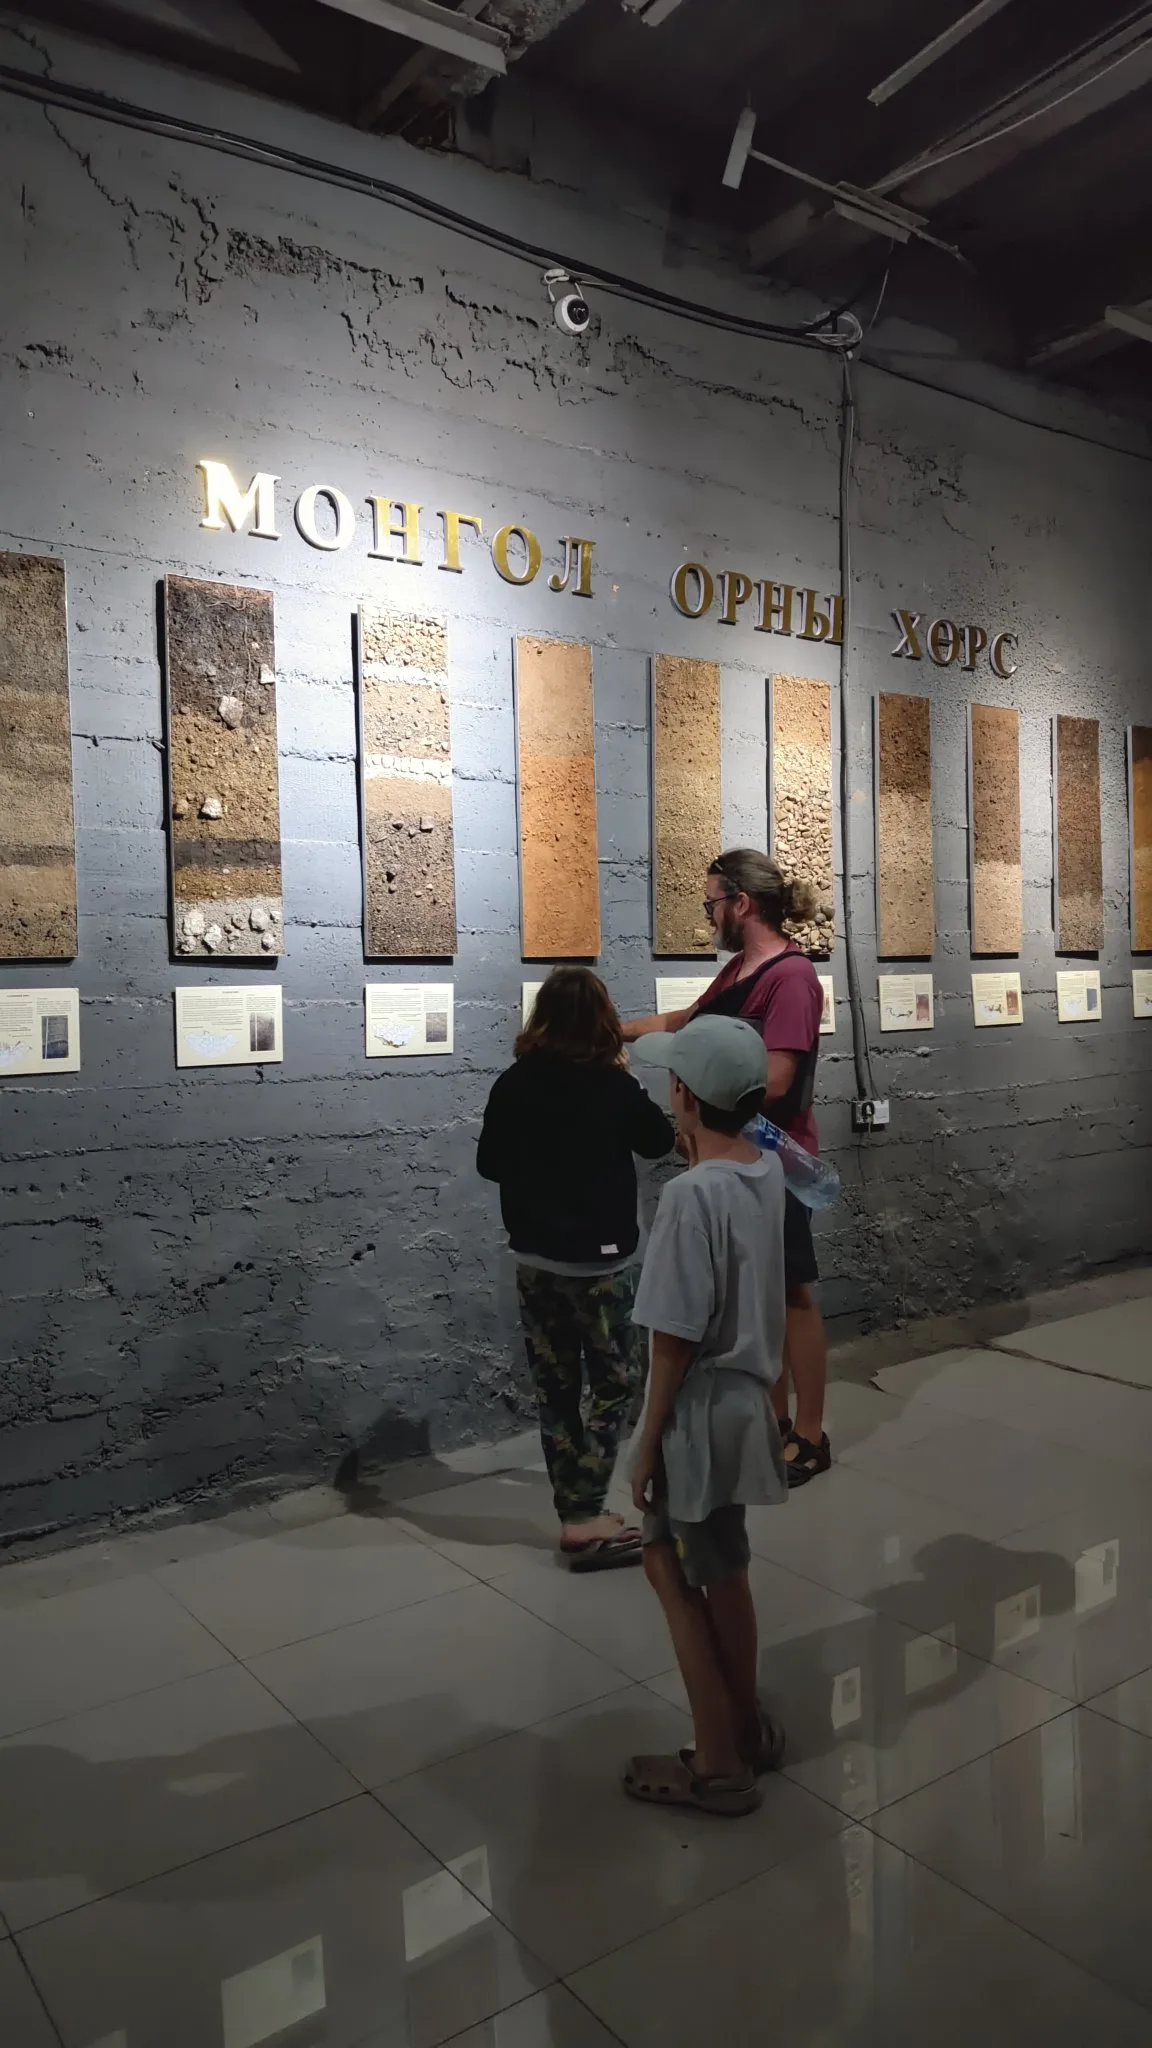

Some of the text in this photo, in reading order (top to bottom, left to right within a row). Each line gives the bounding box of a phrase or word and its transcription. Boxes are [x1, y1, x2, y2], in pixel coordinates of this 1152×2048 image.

[197, 460, 1018, 677] МОНГОЛ ОРНЫ ХӨРС
